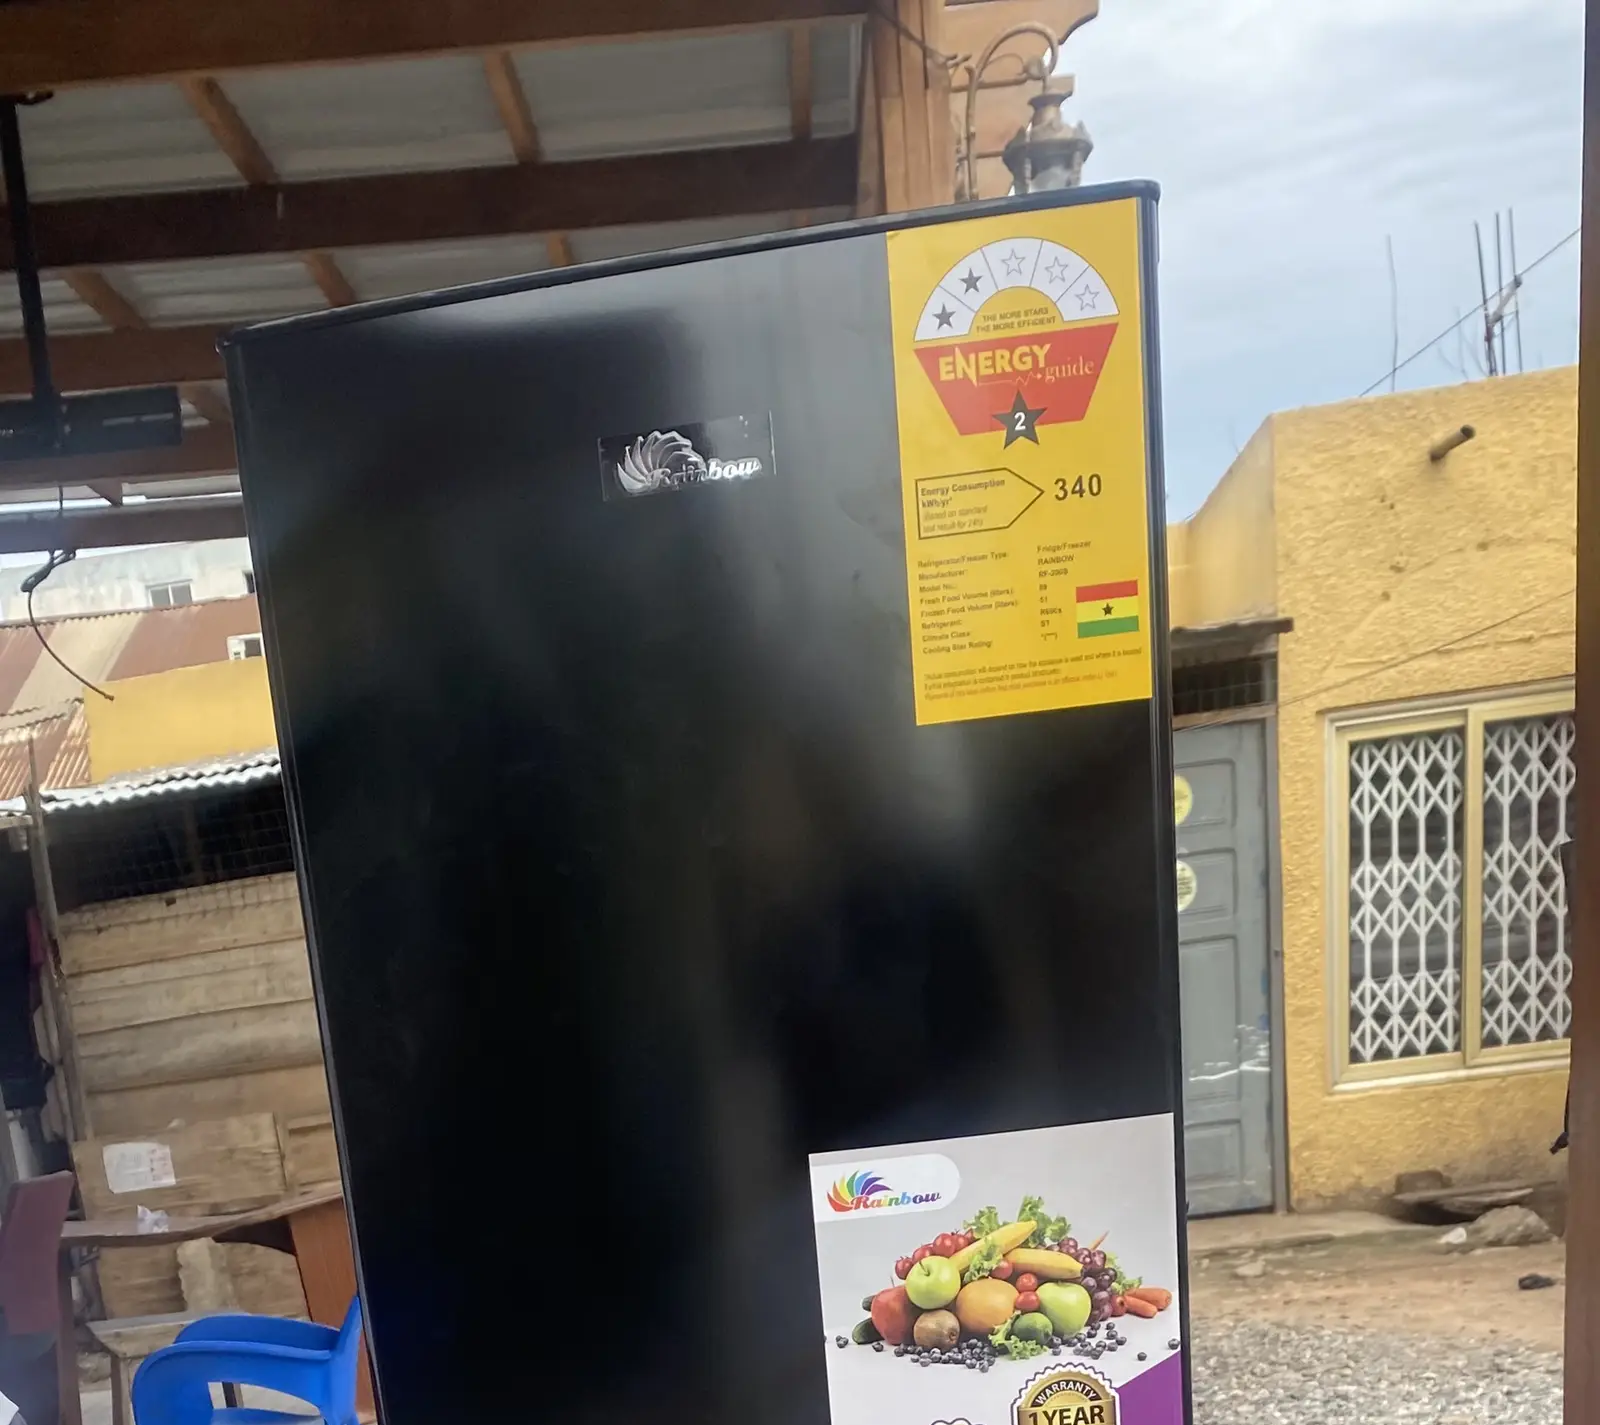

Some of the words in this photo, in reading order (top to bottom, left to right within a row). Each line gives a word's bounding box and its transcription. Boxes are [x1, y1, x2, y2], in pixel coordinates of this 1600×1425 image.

[999, 310, 1021, 319] MORE
[992, 321, 1015, 331] MORE
[938, 344, 1052, 387] ENERGY
[1044, 356, 1095, 384] guide
[1013, 412, 1026, 431] 2
[921, 486, 949, 497] Energy
[951, 479, 1005, 492] Consumption
[1053, 473, 1102, 501] 340
[1037, 554, 1075, 566] RAINBOW
[850, 1191, 942, 1211] Rainbow
[1034, 1379, 1097, 1406] WARRANTY
